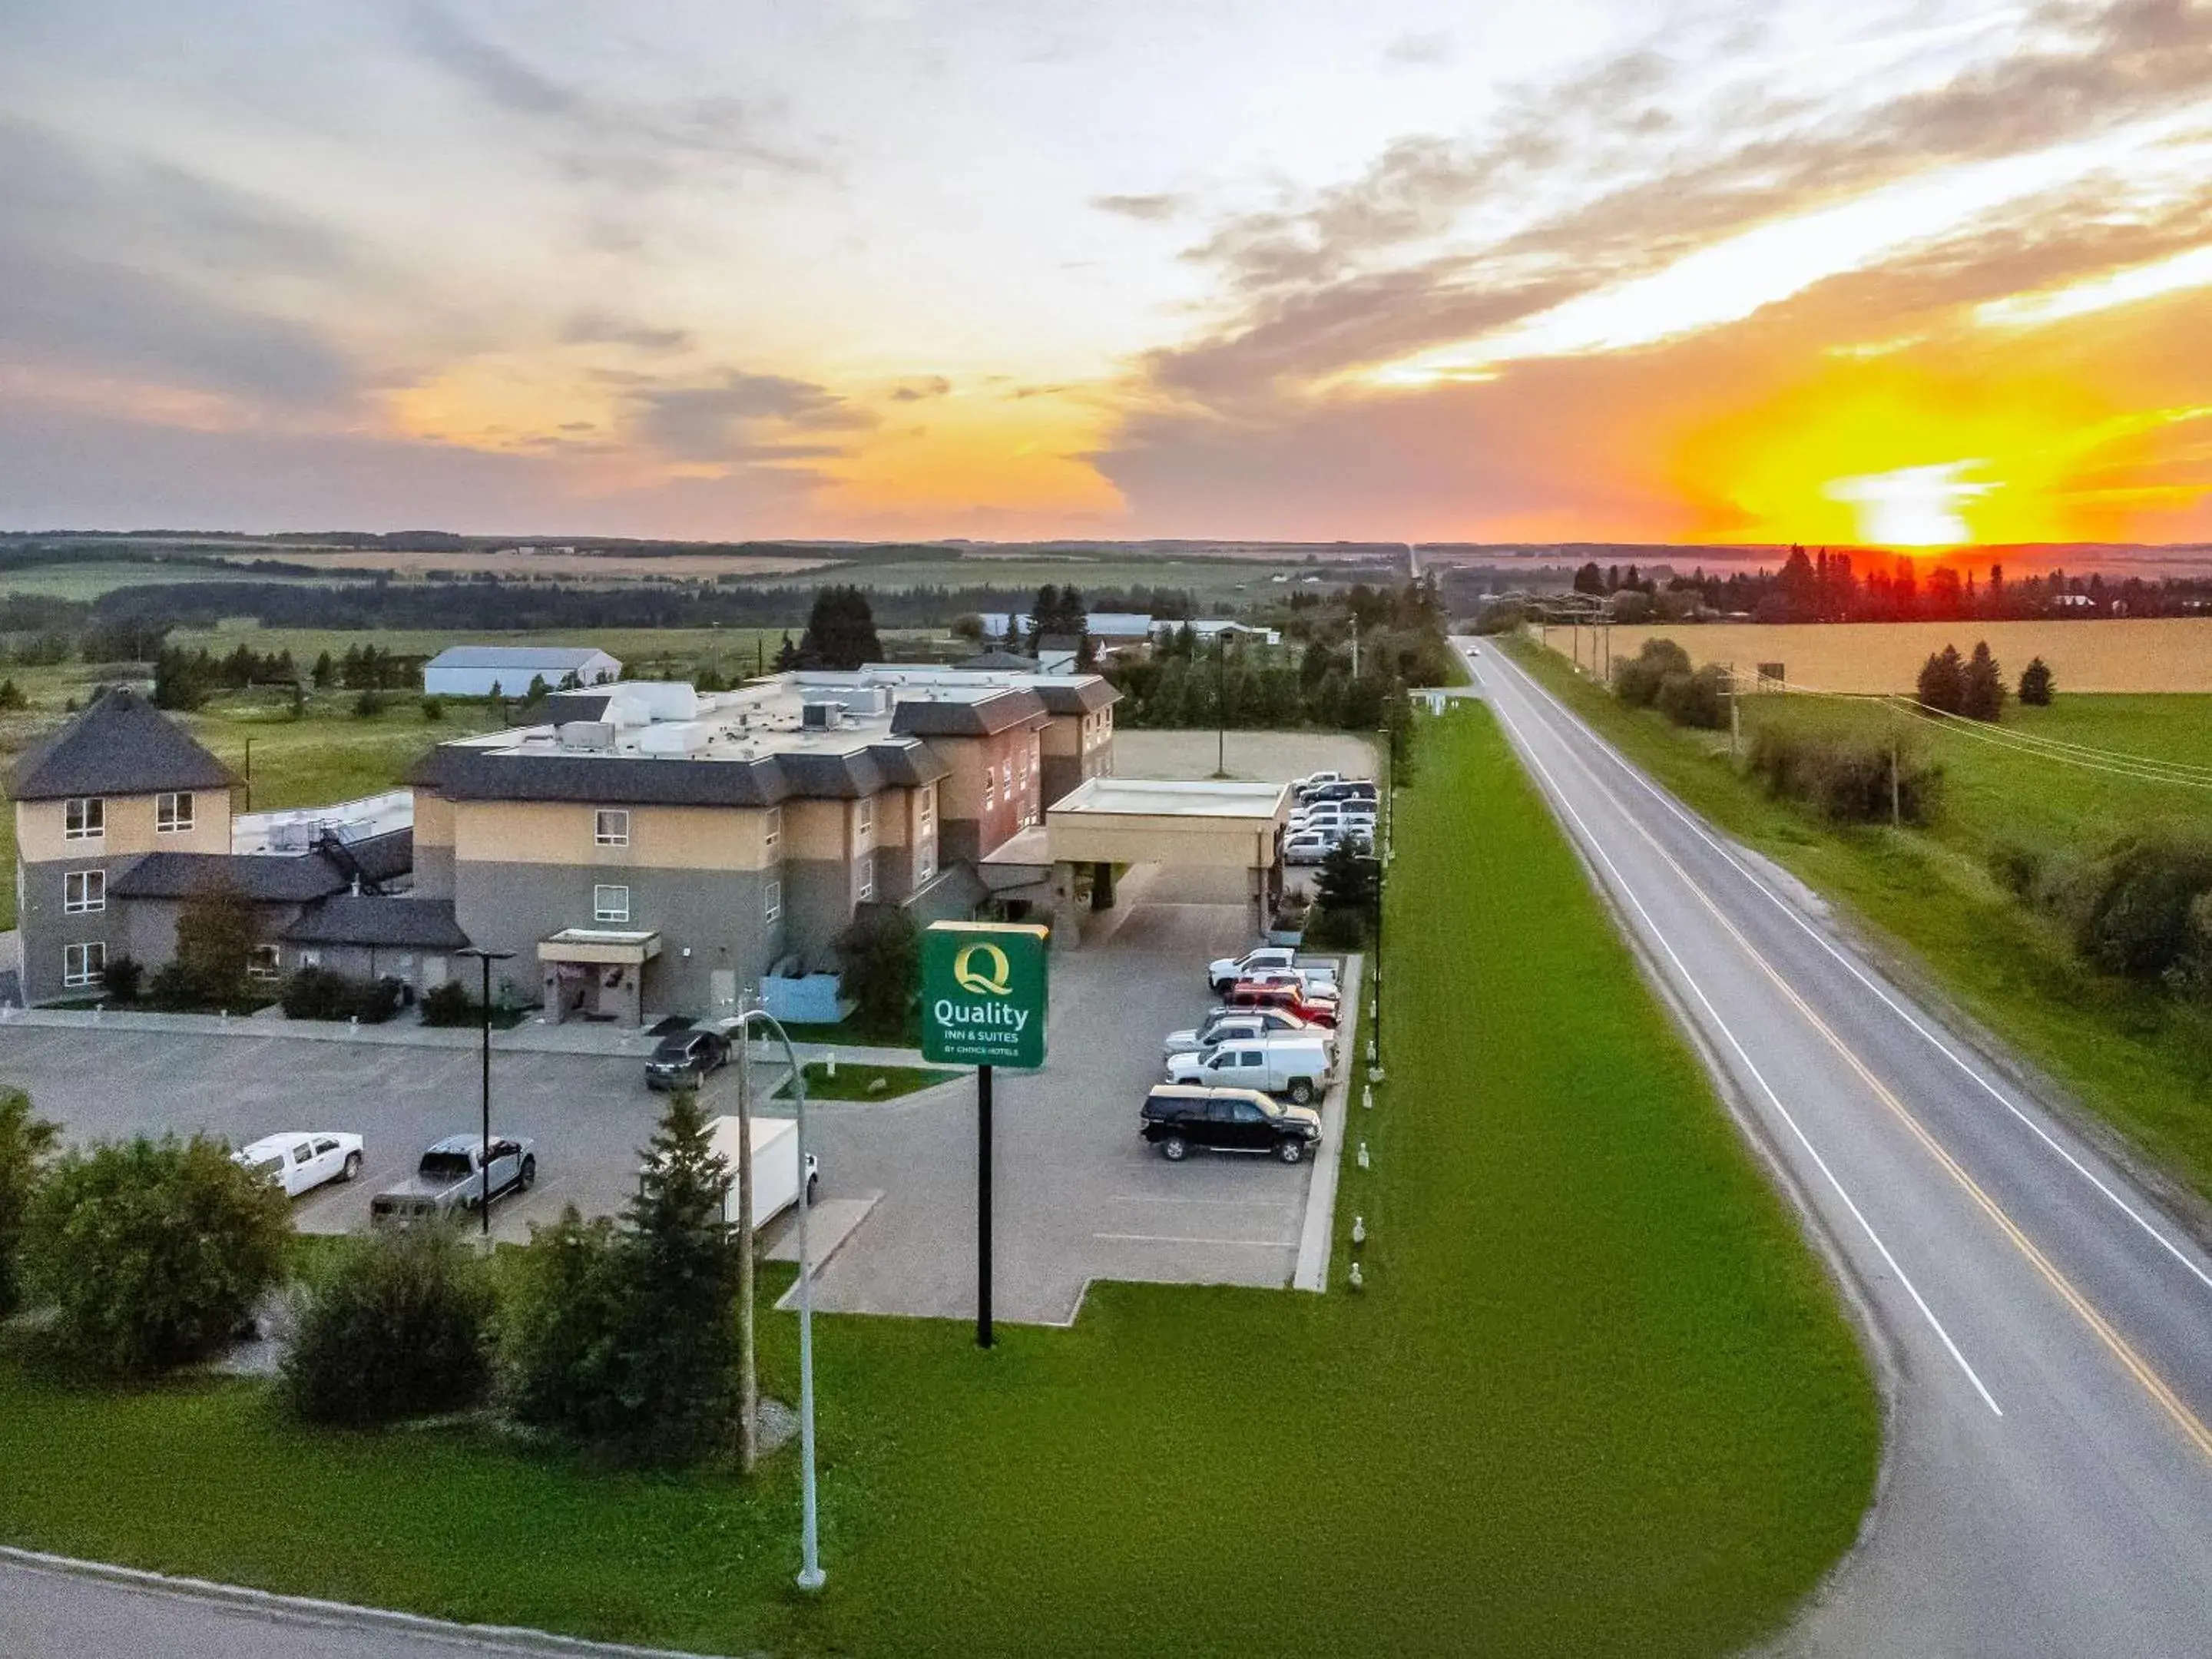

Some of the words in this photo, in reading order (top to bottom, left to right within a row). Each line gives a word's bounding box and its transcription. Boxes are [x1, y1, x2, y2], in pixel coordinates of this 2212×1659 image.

[955, 942, 1013, 995] Q
[935, 999, 1028, 1031] Quality
[945, 1030, 965, 1040] INN
[968, 1030, 976, 1041] &
[978, 1031, 1018, 1043] SUITES
[988, 1048, 1018, 1056] HOTELS
